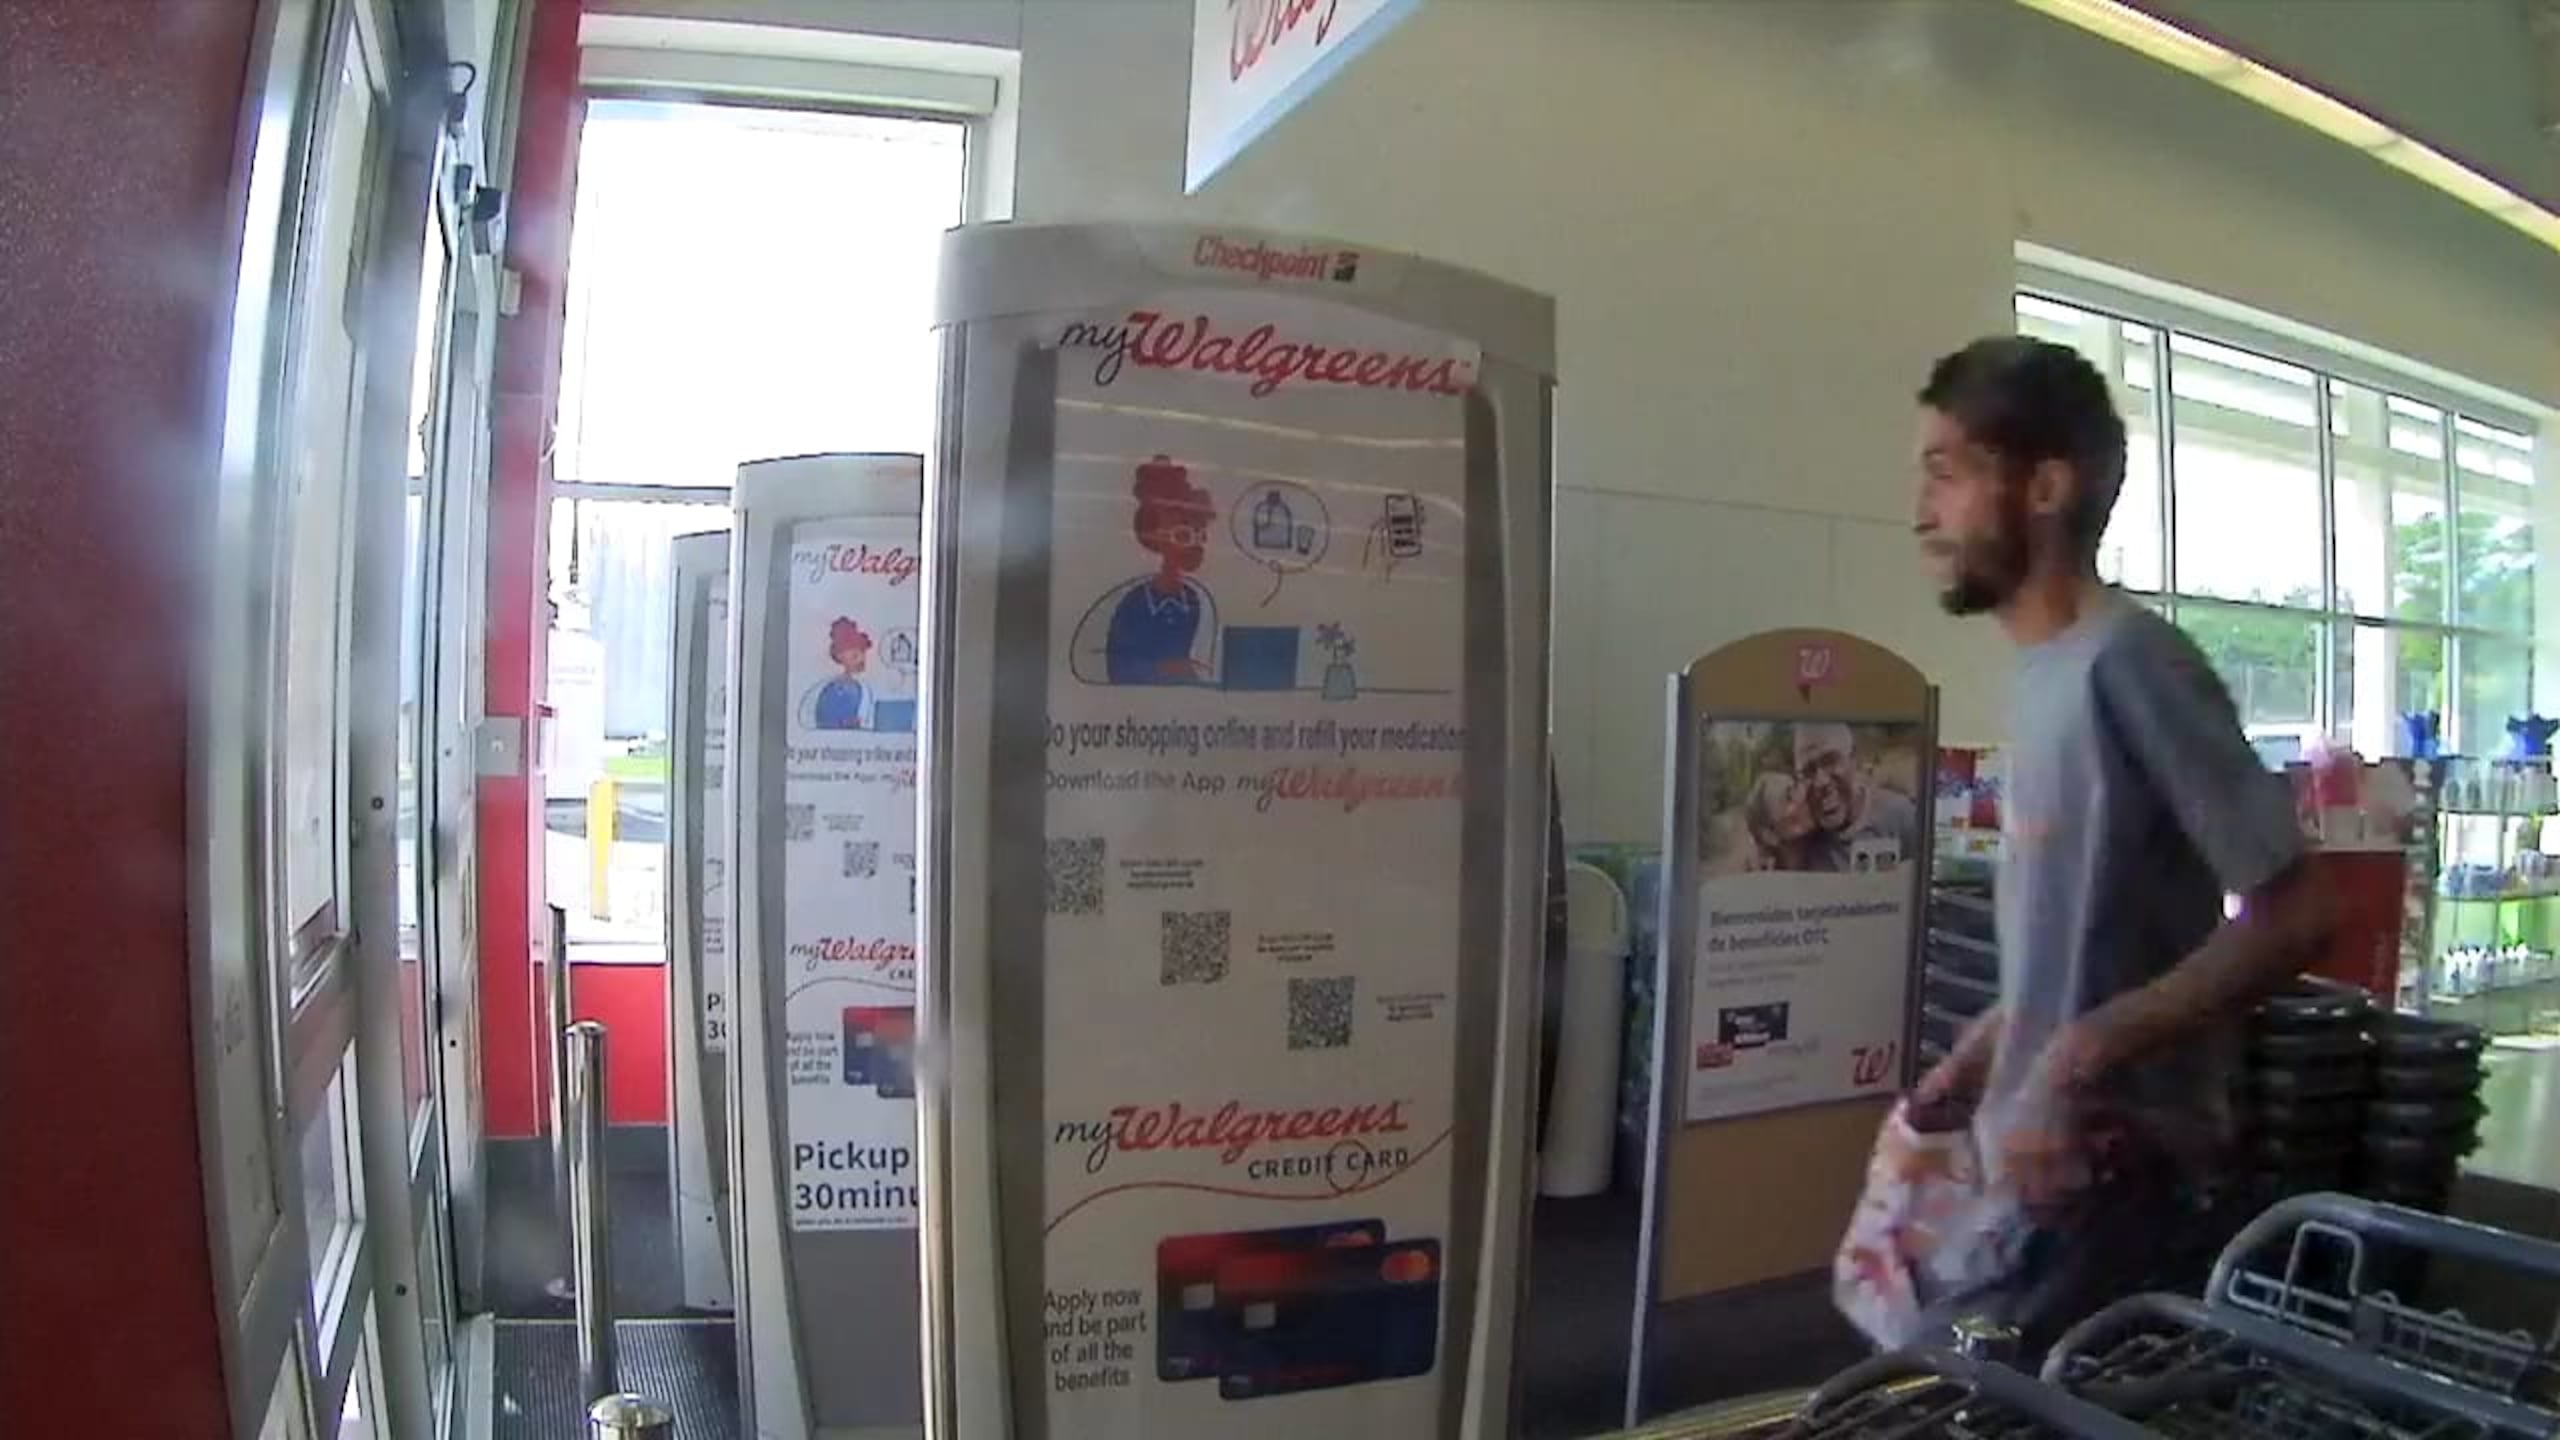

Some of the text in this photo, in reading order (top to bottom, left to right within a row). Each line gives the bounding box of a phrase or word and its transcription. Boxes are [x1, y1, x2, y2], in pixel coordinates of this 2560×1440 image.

[1194, 234, 1328, 282] Checkpoint
[1070, 723, 1111, 756] your
[1116, 717, 1198, 756] shopping
[1203, 717, 1256, 750] online
[1340, 726, 1377, 757] your
[1183, 770, 1226, 796] App
[795, 1140, 910, 1175] Pickup
[1248, 1147, 1409, 1180] CREDIT CARD
[1042, 1288, 1142, 1313] Apply now
[1080, 1315, 1102, 1335] be
[1108, 1311, 1147, 1338] part
[1052, 1340, 1132, 1364] of all the
[1055, 1367, 1130, 1391] benefits
